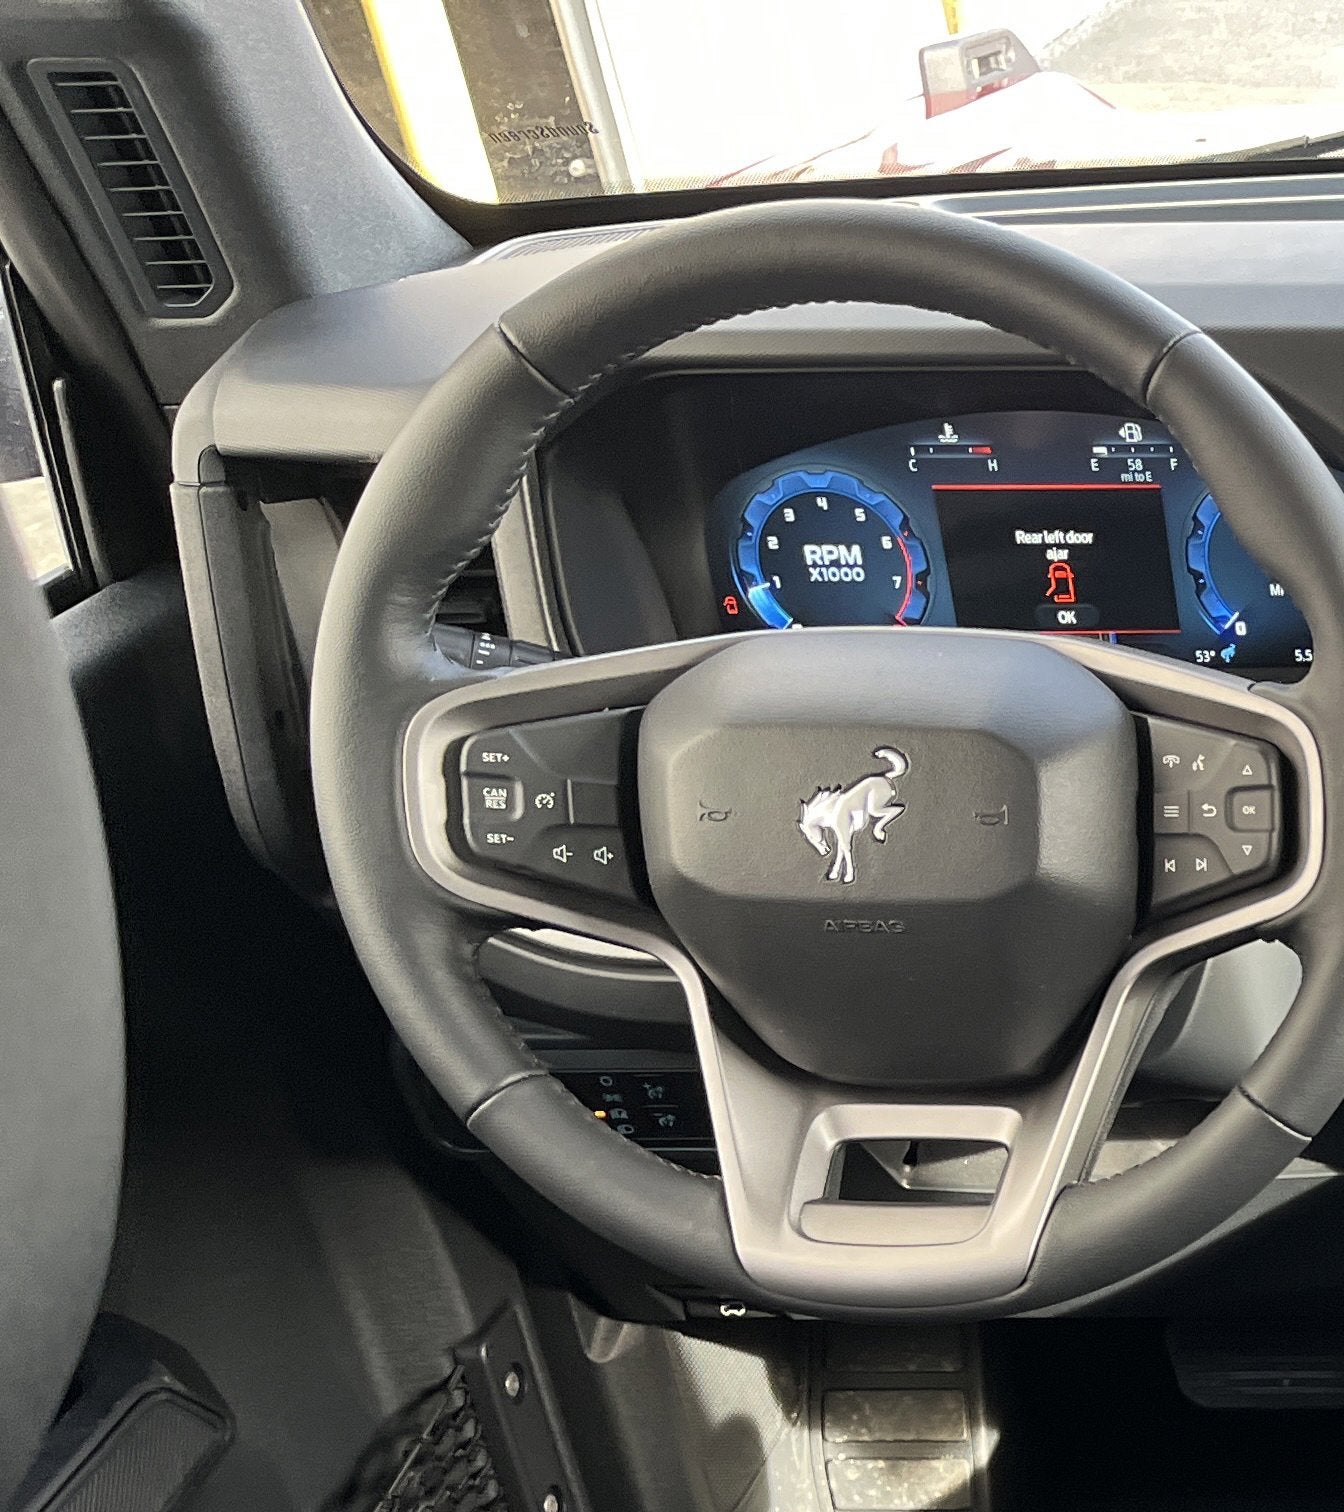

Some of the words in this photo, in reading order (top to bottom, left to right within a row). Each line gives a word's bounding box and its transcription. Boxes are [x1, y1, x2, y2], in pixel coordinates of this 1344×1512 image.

[908, 458, 918, 472] C
[988, 459, 998, 472] H
[1090, 458, 1100, 471] E
[1127, 458, 1143, 471] 58
[1170, 458, 1178, 471] F
[1121, 473, 1134, 482] mi
[1135, 473, 1145, 482] to
[1146, 472, 1153, 482] E
[816, 496, 828, 511] 4
[783, 508, 795, 522] 3
[854, 508, 866, 522] 5
[767, 536, 780, 550] 2
[881, 536, 893, 550] 6
[1015, 530, 1043, 544] Rear
[1045, 530, 1065, 544] left
[1066, 530, 1093, 544] door
[803, 544, 863, 566] RPM
[1046, 548, 1069, 562] ajar
[808, 566, 865, 583] X1000
[772, 575, 781, 589] 1
[892, 575, 902, 589] 7
[1057, 610, 1077, 625] OK
[1235, 621, 1247, 636] 0
[482, 787, 507, 797] CAN
[485, 799, 507, 810] RES
[1242, 805, 1256, 815] OK
